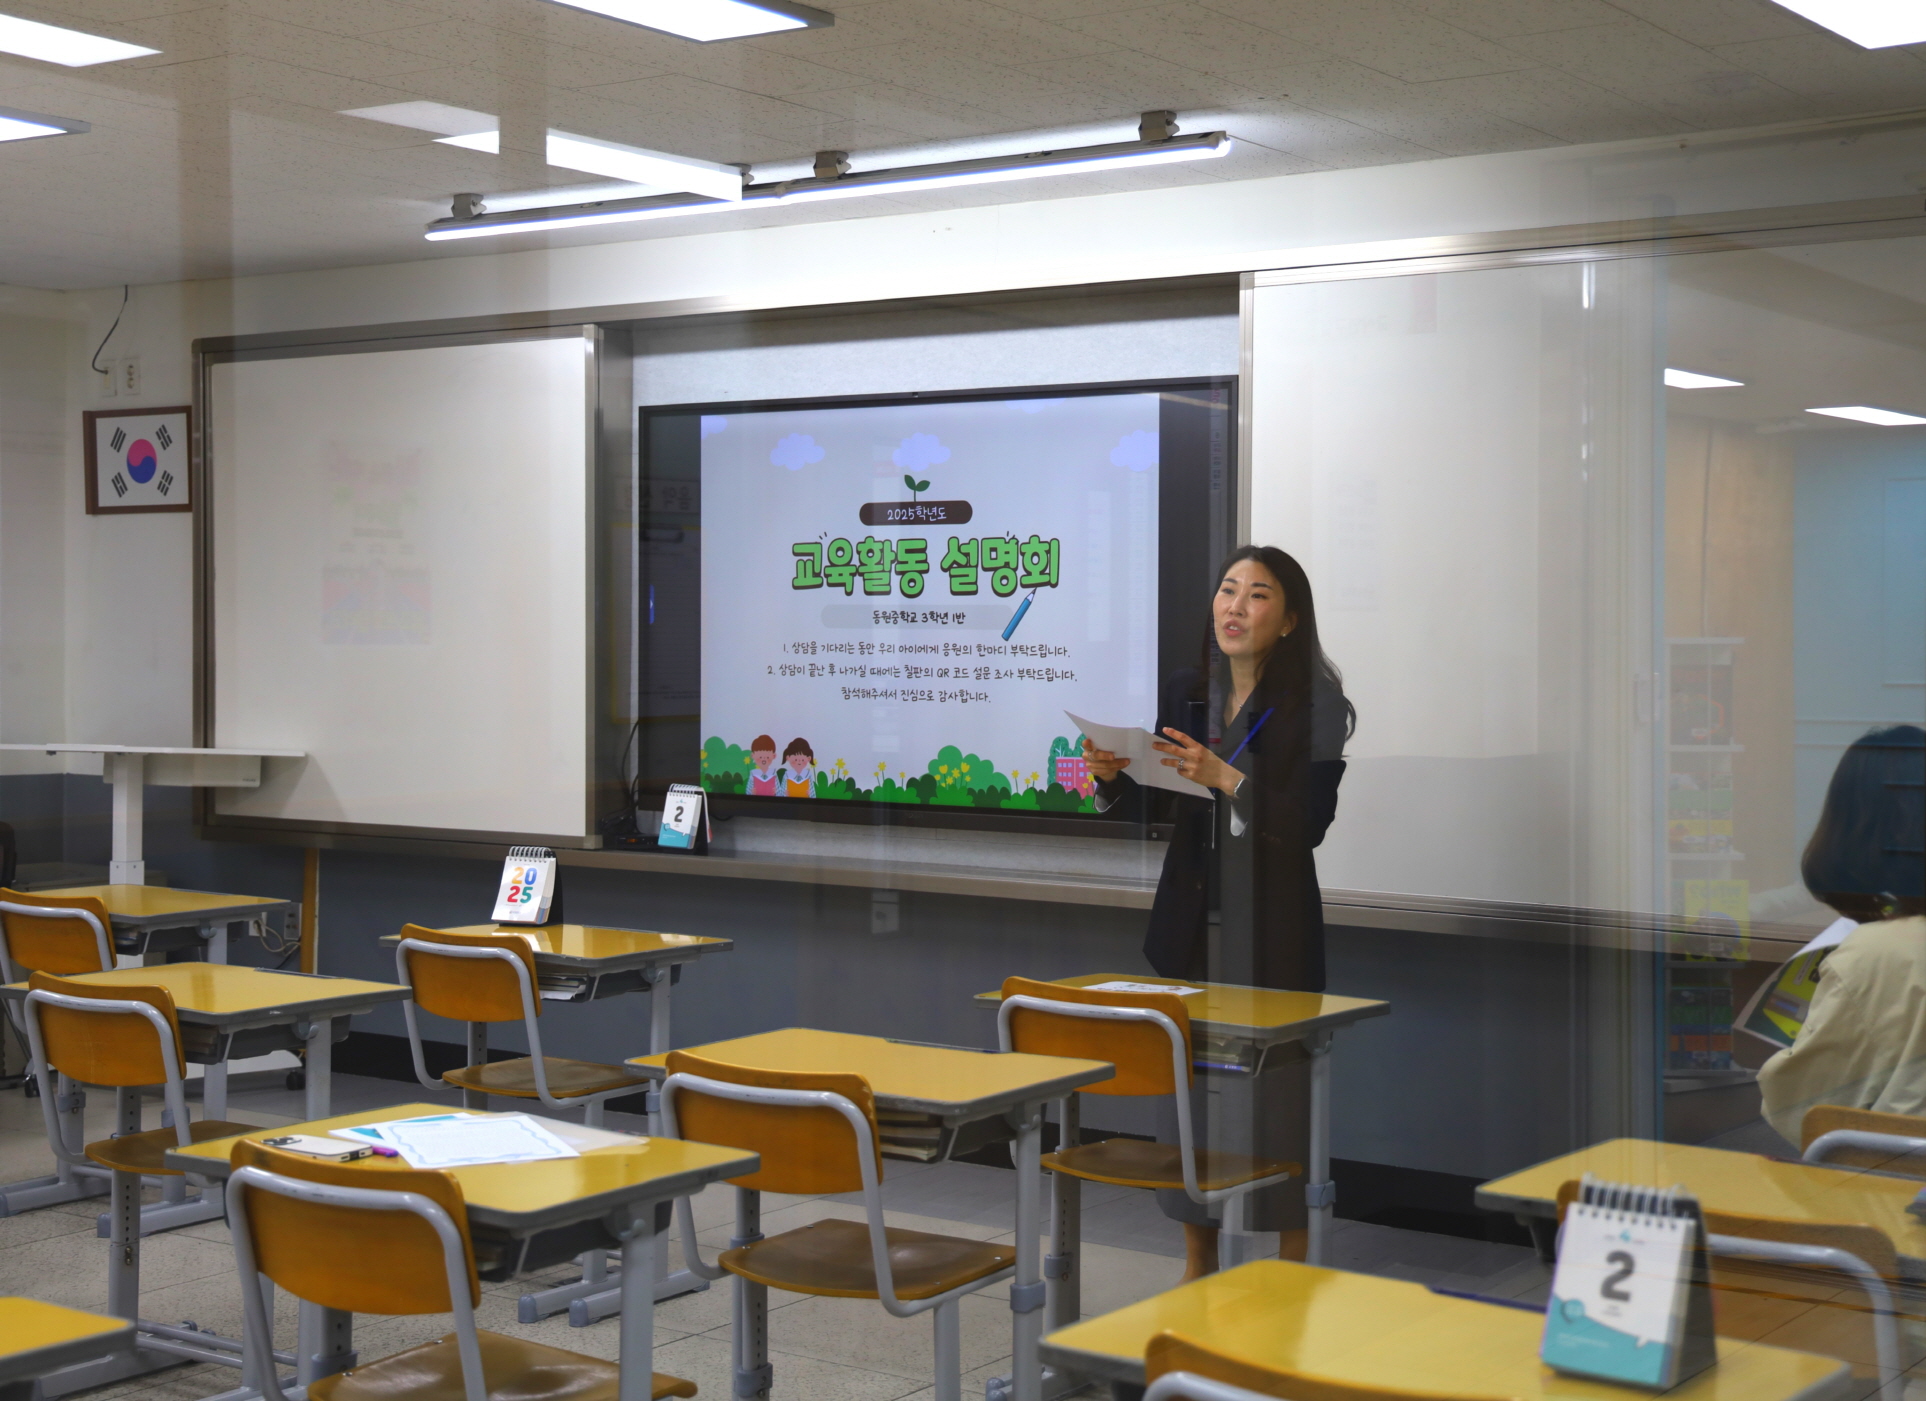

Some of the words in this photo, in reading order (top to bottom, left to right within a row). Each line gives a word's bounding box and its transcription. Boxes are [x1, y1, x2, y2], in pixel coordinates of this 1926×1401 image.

[887, 505, 947, 522] 2025학년도
[791, 535, 930, 599] 교육활동
[940, 534, 1061, 598] 설명회
[872, 609, 919, 625] 동원중학교
[920, 610, 949, 625] 3학년
[952, 611, 967, 625] 1반
[783, 643, 789, 654] 1.
[791, 640, 818, 656] 상담을
[820, 641, 856, 655] 기다리는
[857, 641, 876, 656] 동안
[878, 642, 896, 655] 우리
[898, 643, 940, 655] 아이에게
[942, 642, 973, 657] 응원의
[975, 643, 1007, 658] 한마디
[1010, 643, 1071, 659] 부탁드립니다.
[767, 665, 776, 676] 2.
[778, 663, 806, 677] 상담이
[807, 662, 826, 678] 끝난
[828, 662, 837, 677] 후
[839, 664, 867, 678] 나가실
[869, 665, 902, 679] 때에는
[903, 664, 934, 680] 칠판의
[936, 667, 950, 679] QR
[952, 666, 970, 679] 코드
[973, 666, 992, 681] 설문
[994, 668, 1015, 680] 조사
[1016, 667, 1078, 683] 부탁드립니다.
[840, 686, 898, 701] 참석해주셔서
[900, 688, 936, 703] 진심으로
[938, 688, 992, 704] 감사합니다.
[673, 805, 684, 823] 2
[511, 866, 538, 886] 20
[506, 885, 533, 904] 25
[1600, 1250, 1635, 1303] 2
